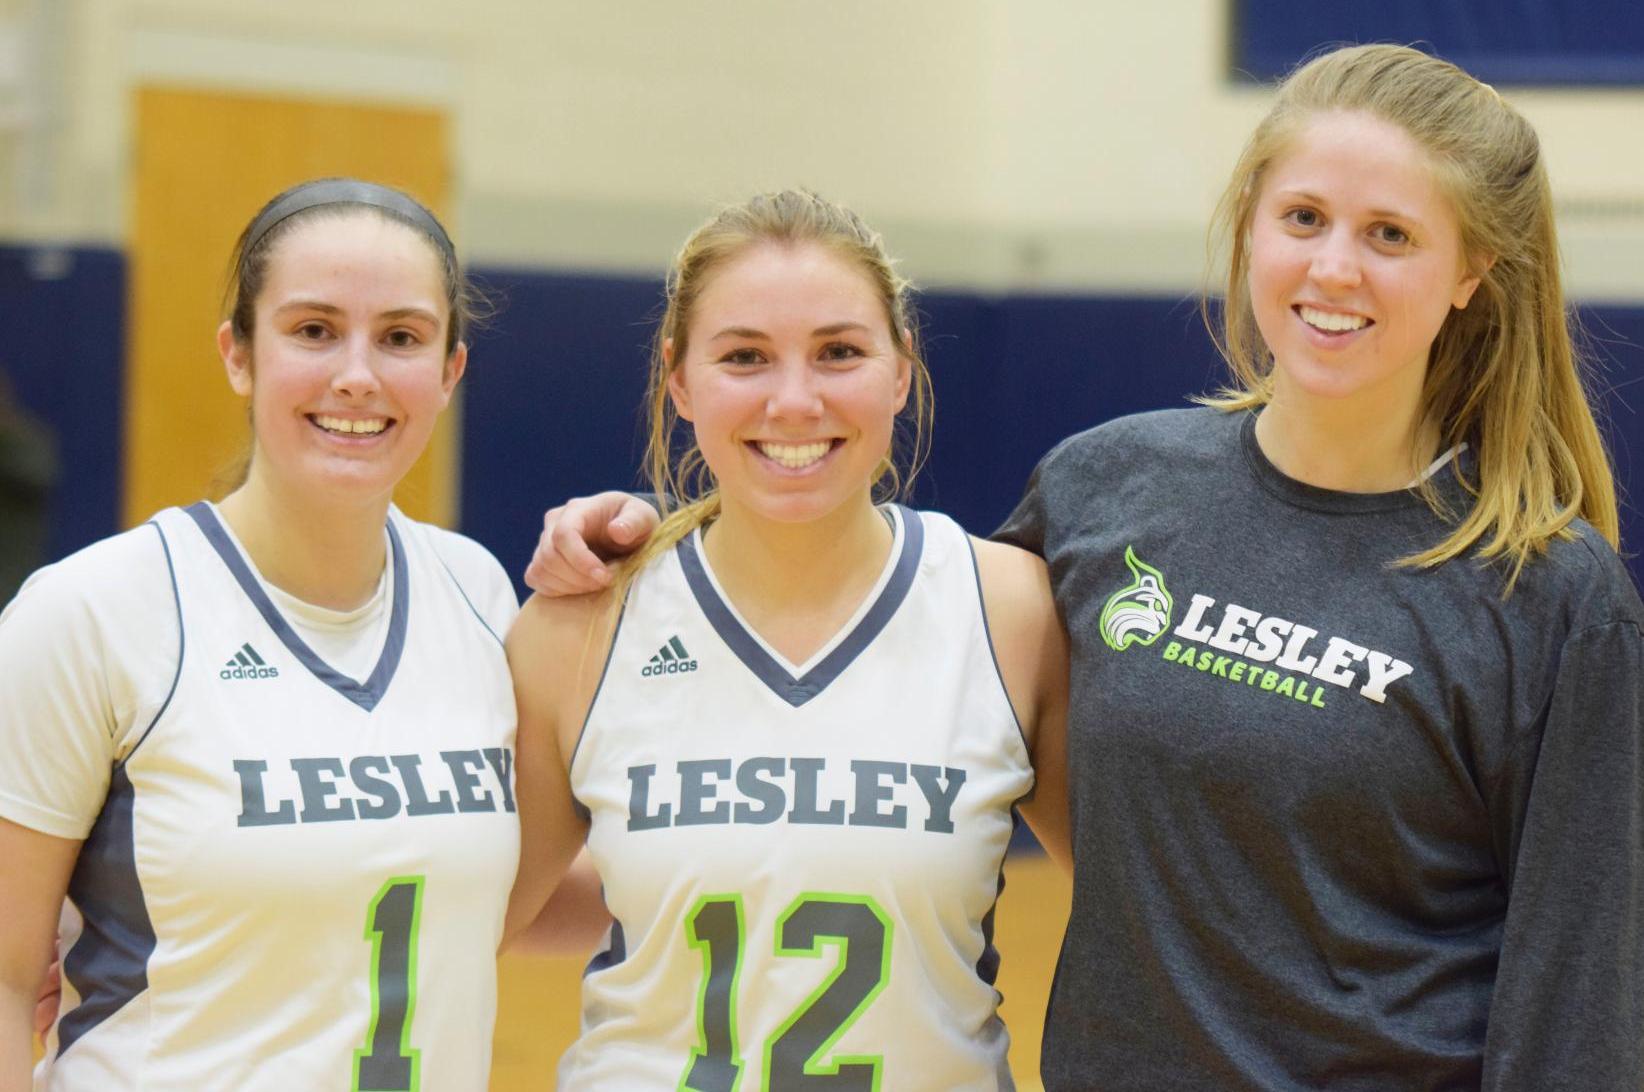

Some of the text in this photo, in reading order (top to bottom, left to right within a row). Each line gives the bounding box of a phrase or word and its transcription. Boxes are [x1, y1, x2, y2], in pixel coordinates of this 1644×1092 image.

[219, 665, 279, 680] adidas
[641, 659, 698, 677] adidas
[1163, 641, 1327, 708] BASKETBALL
[1174, 593, 1414, 704] LESLEY
[232, 747, 516, 828] LESLEY
[627, 757, 967, 834] LESLEY
[351, 875, 425, 1092] 1
[676, 891, 895, 1092] 12
